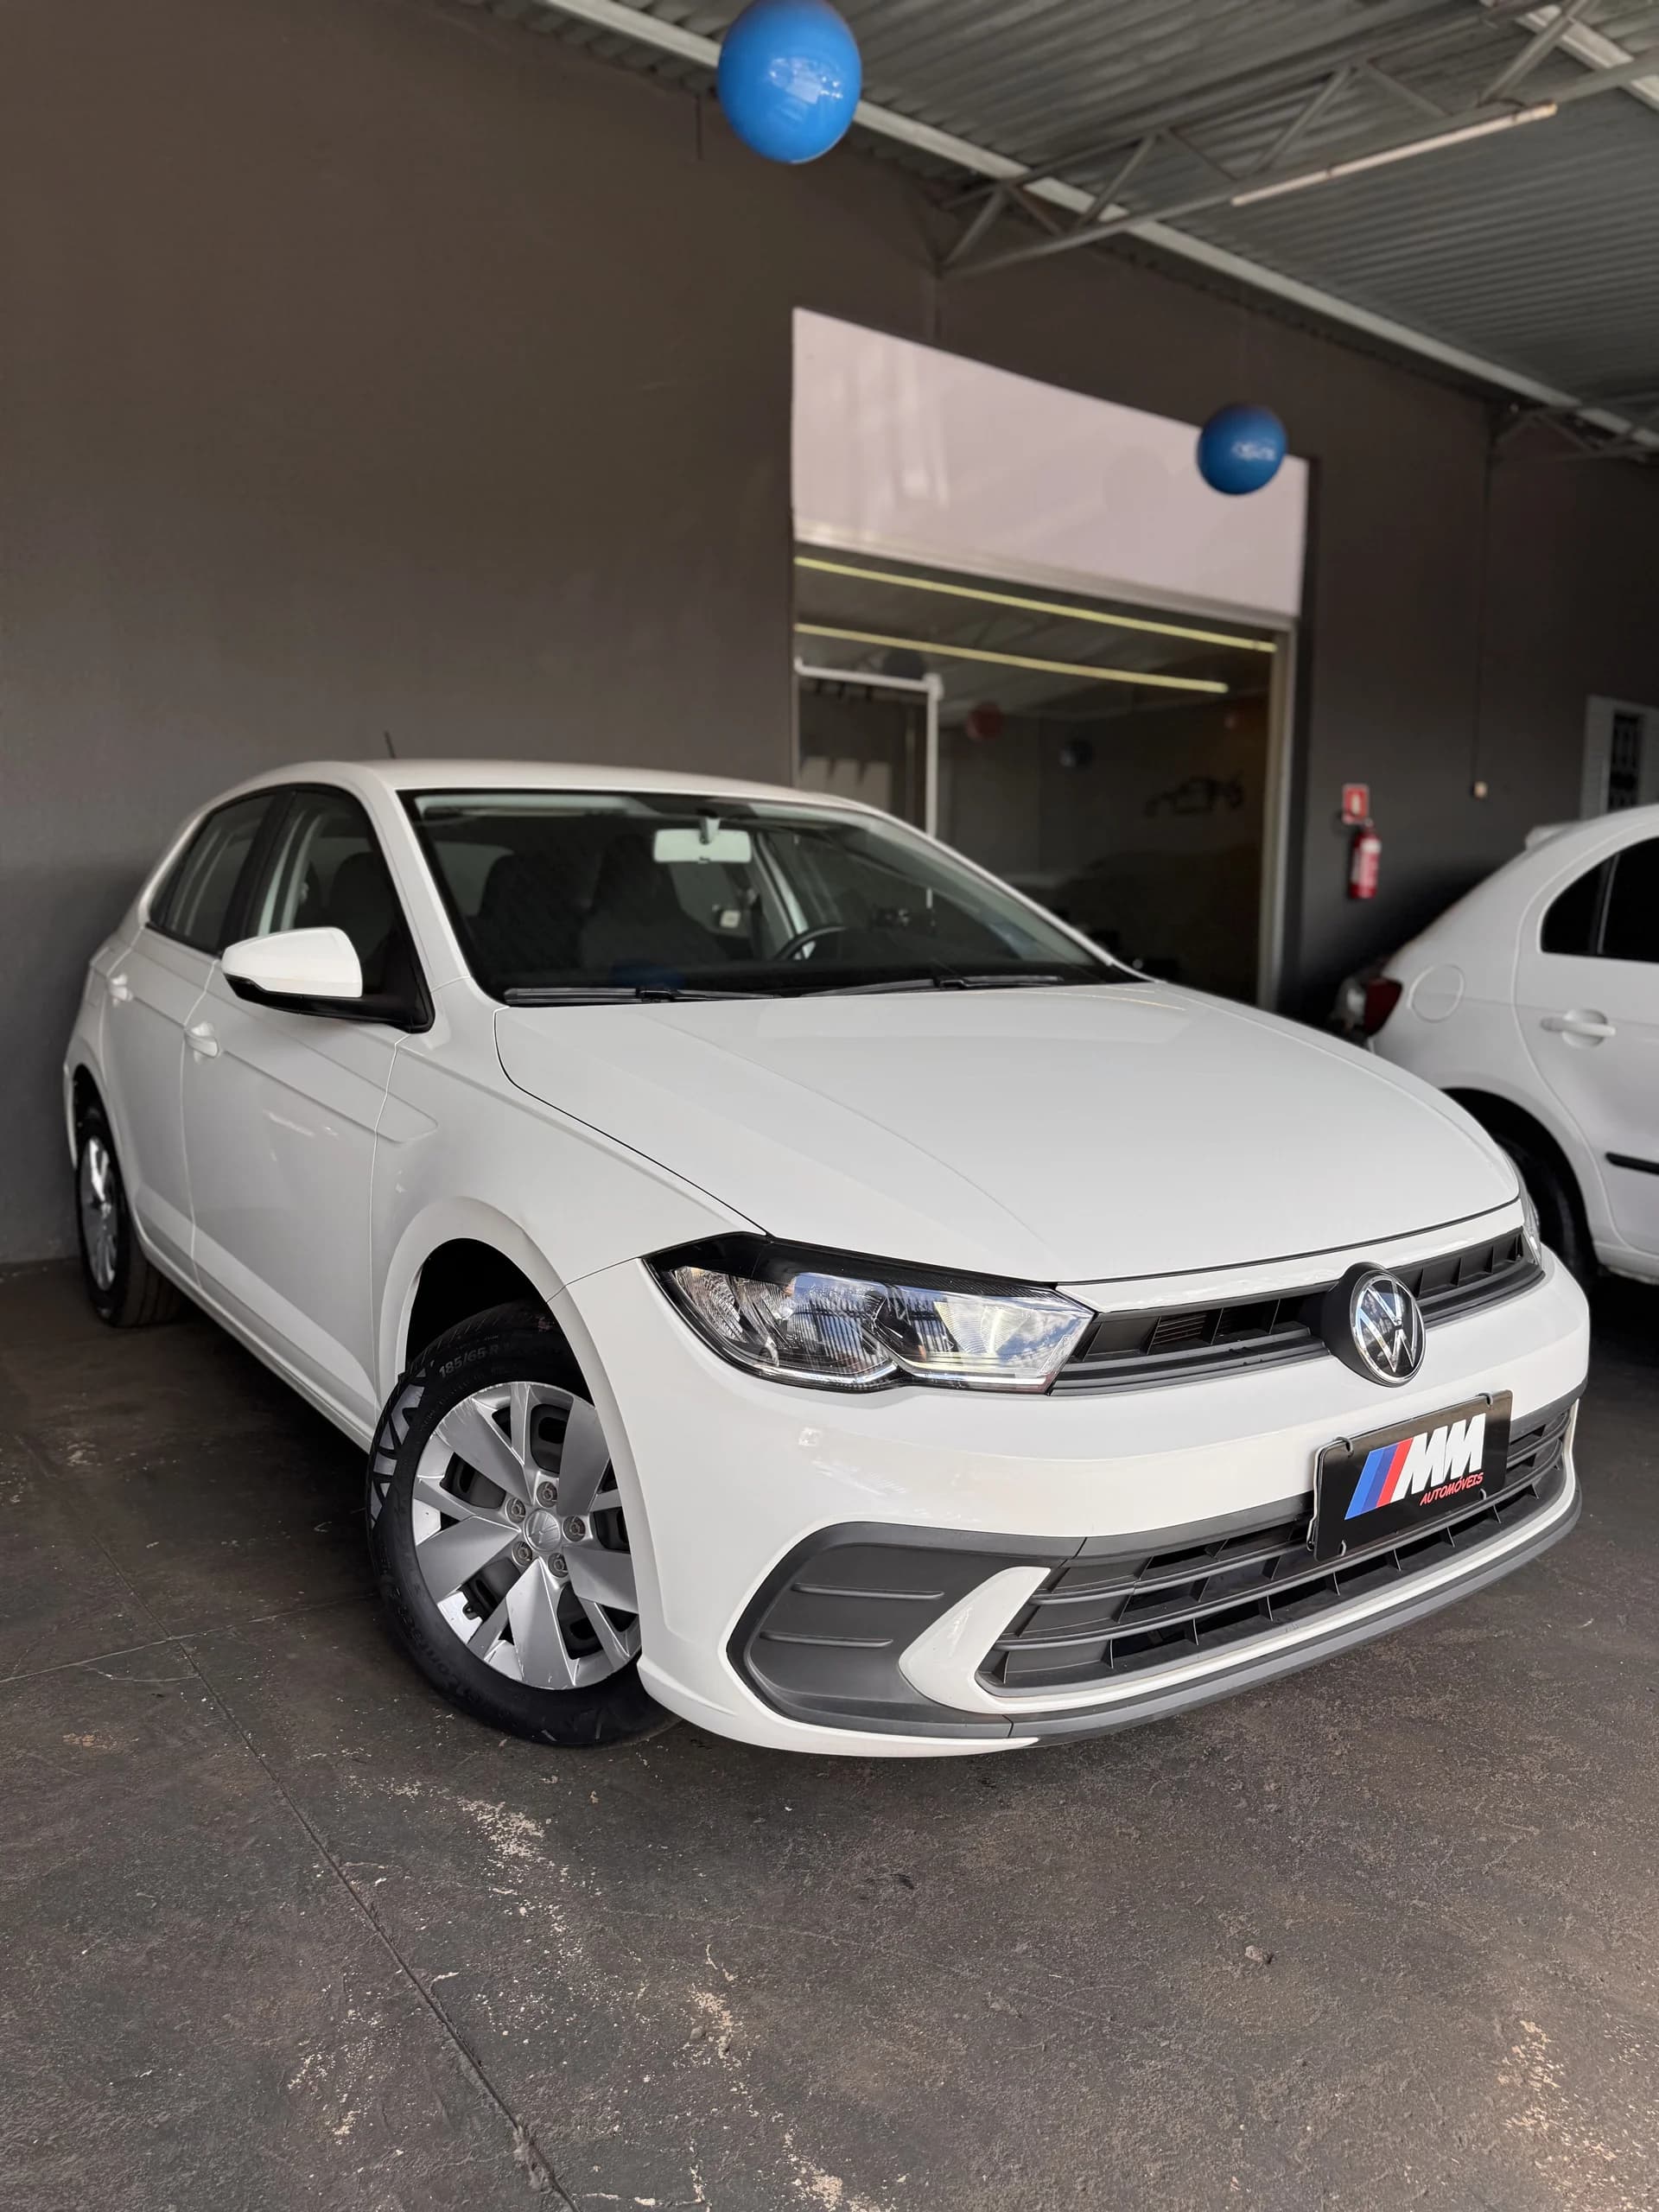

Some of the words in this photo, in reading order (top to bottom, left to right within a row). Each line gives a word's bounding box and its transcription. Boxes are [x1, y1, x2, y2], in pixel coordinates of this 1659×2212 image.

[1354, 1274, 1422, 1380] VW
[439, 1347, 486, 1378] 185/65
[1389, 1413, 1486, 1503] MM
[1420, 1472, 1484, 1506] AUTOMÓVEIS
